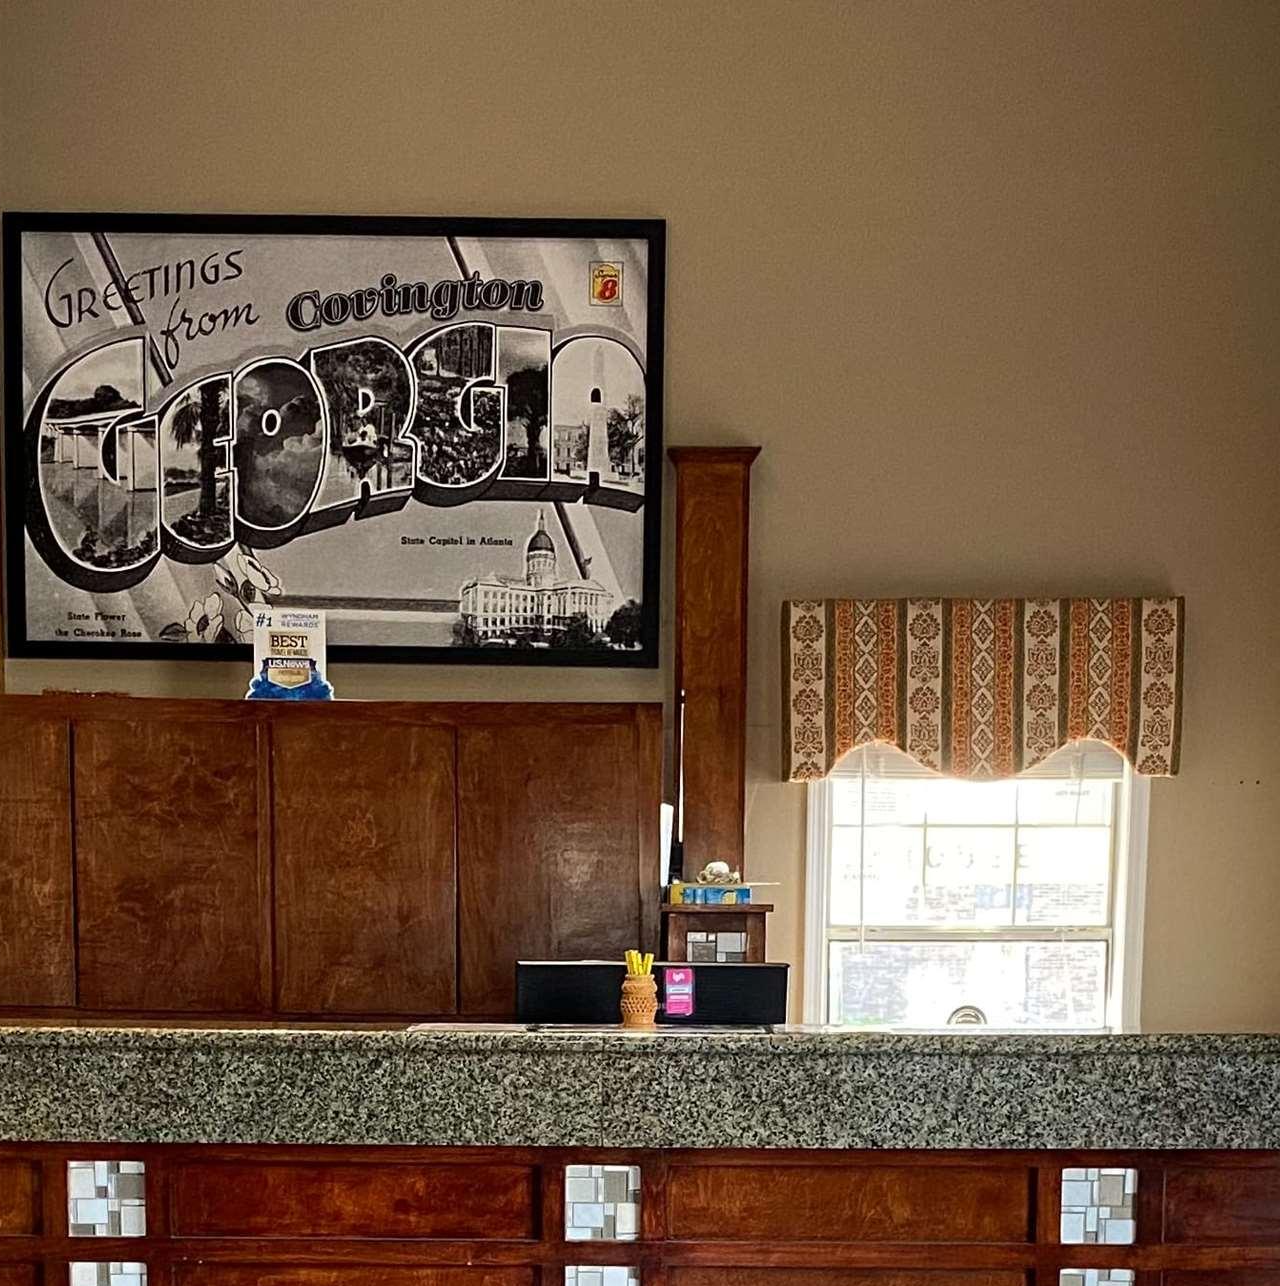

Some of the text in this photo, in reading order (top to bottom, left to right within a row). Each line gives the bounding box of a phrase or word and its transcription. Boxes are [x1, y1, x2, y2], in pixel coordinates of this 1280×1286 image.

[596, 278, 619, 302] 8
[286, 272, 545, 332] Covington
[160, 297, 260, 370] from
[23, 322, 648, 594] GEORGIA
[401, 536, 513, 546] State Capitol in Atlanta
[67, 611, 127, 621] State Flower
[256, 613, 272, 628] #1
[73, 628, 116, 637] Cherokee
[271, 634, 308, 648] BEST
